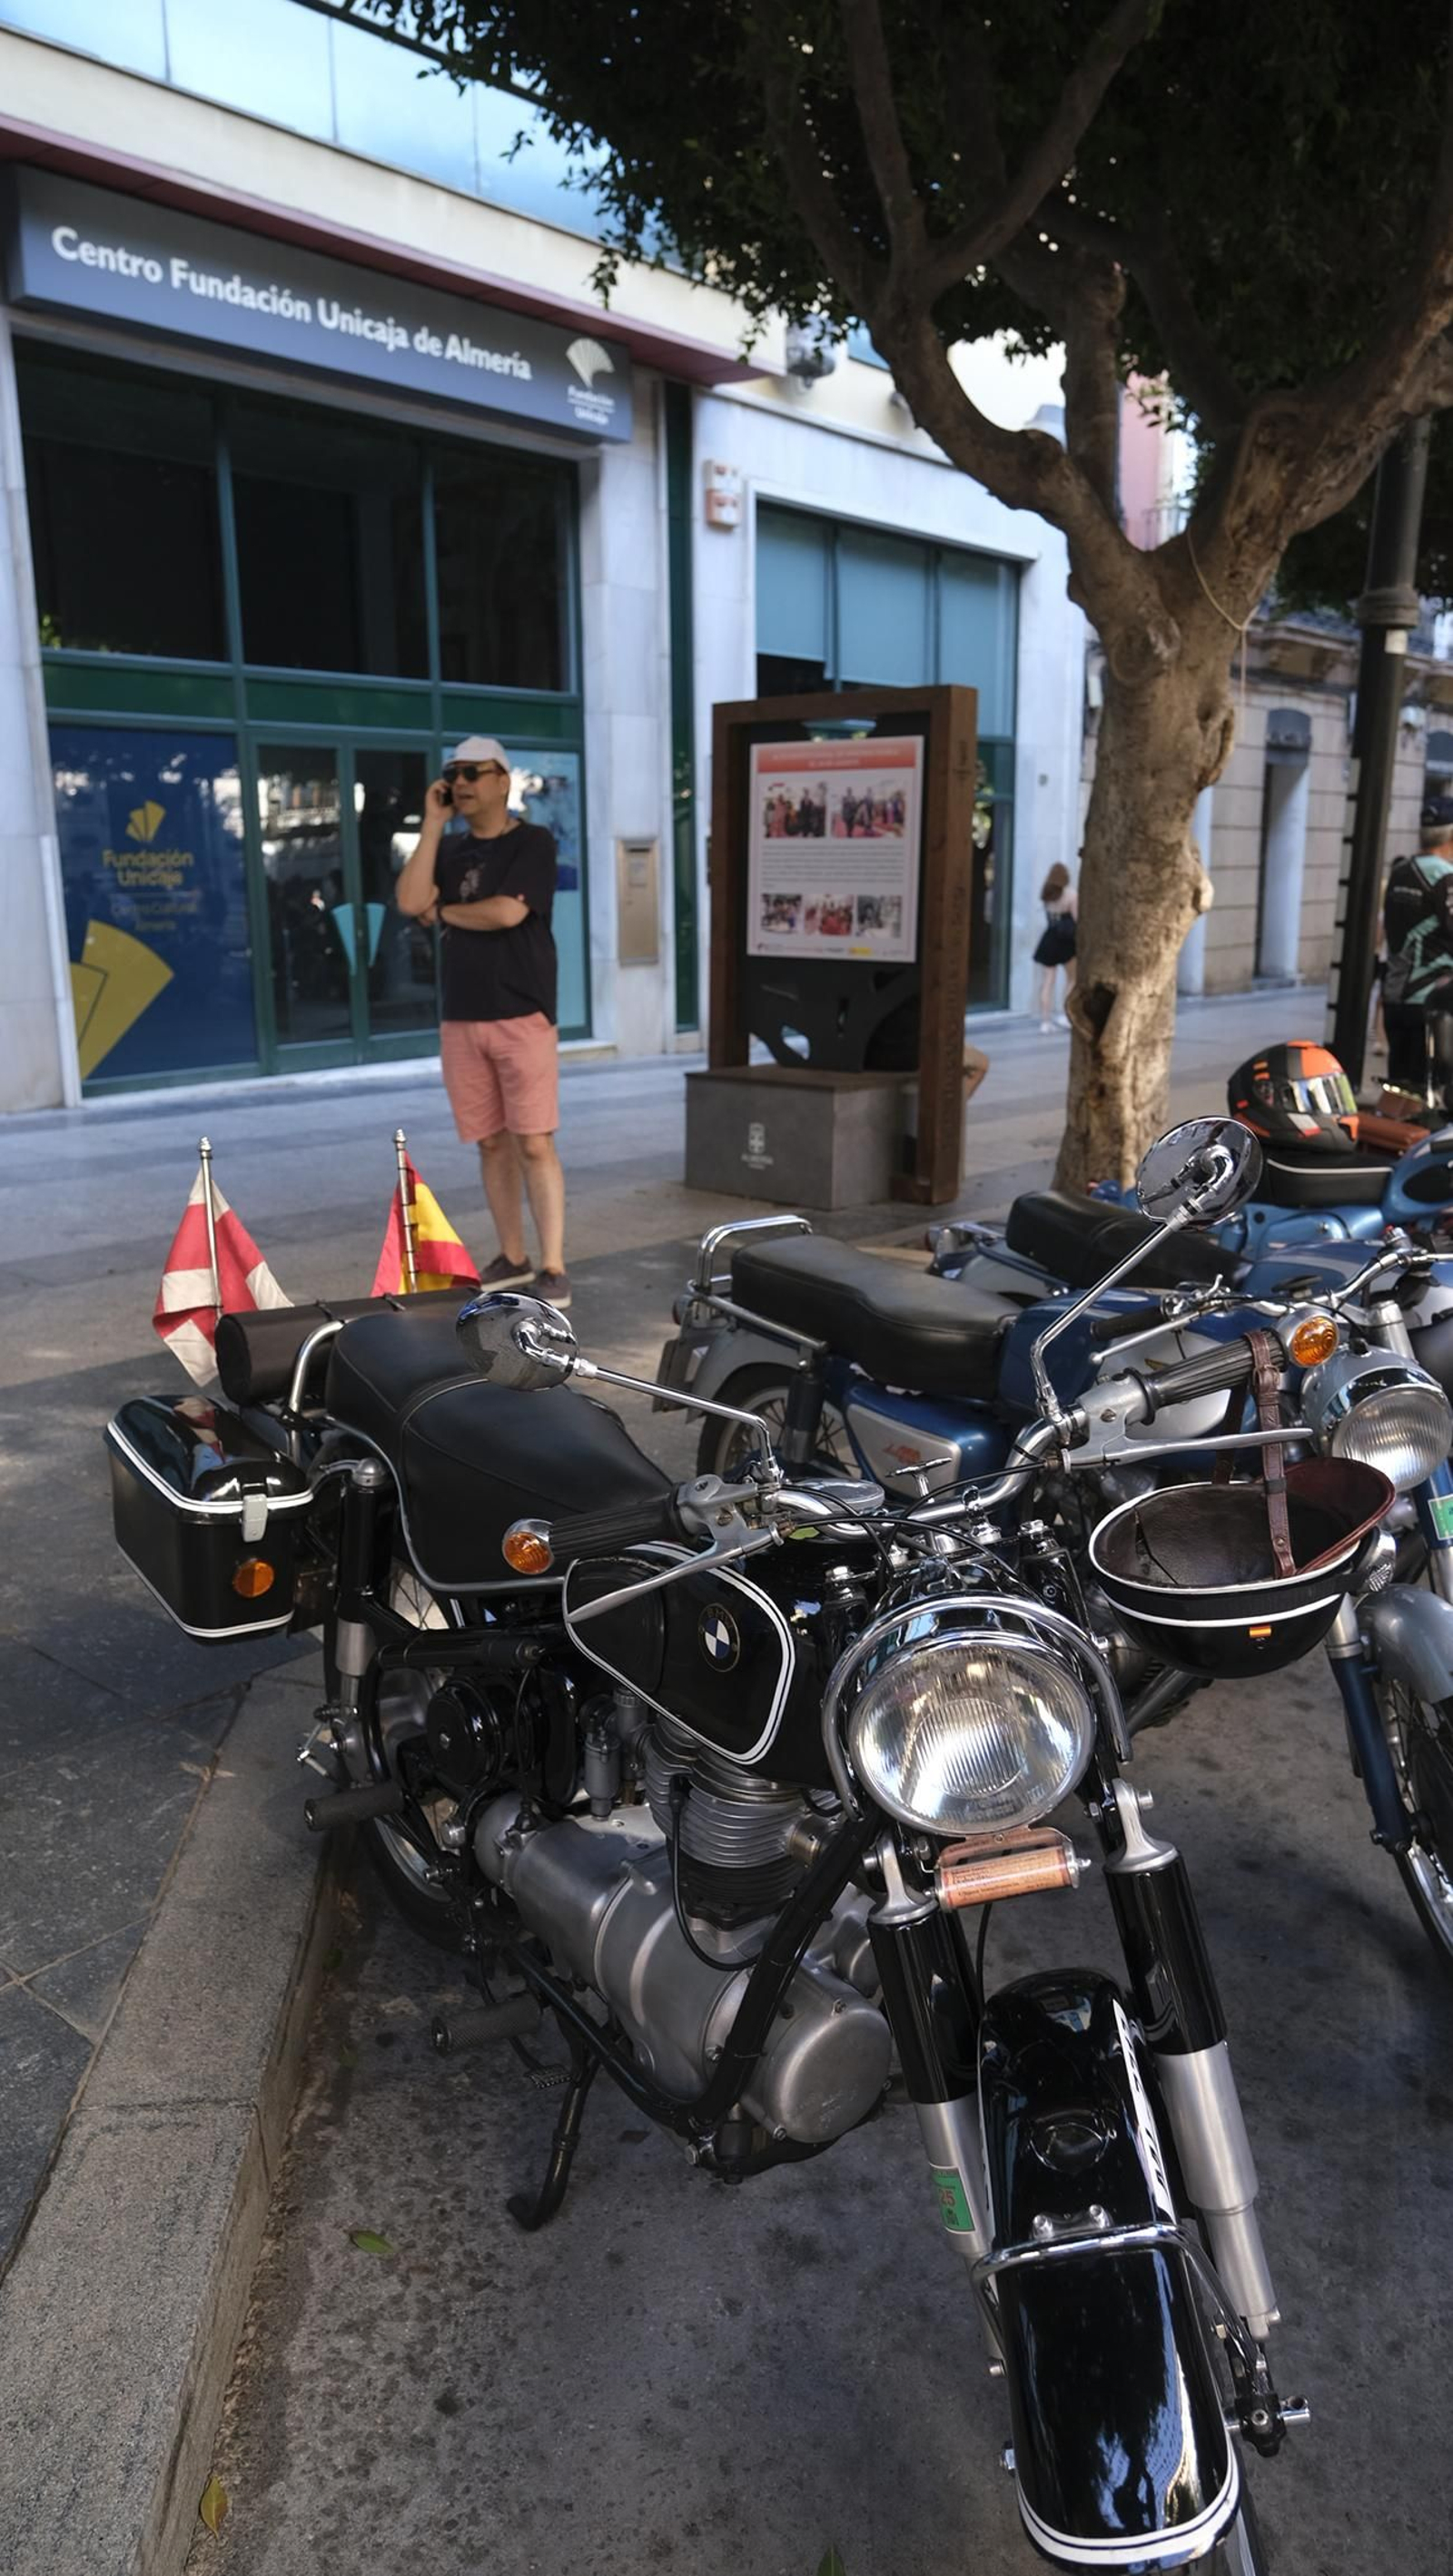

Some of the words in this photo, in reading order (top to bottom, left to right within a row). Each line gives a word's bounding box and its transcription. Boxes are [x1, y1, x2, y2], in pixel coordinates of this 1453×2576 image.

[52, 226, 163, 283] Centro
[169, 258, 311, 323] Fundación
[317, 297, 410, 352] Unicaja
[413, 325, 443, 358] de
[444, 332, 532, 380] Almería
[103, 849, 193, 868] Fundación
